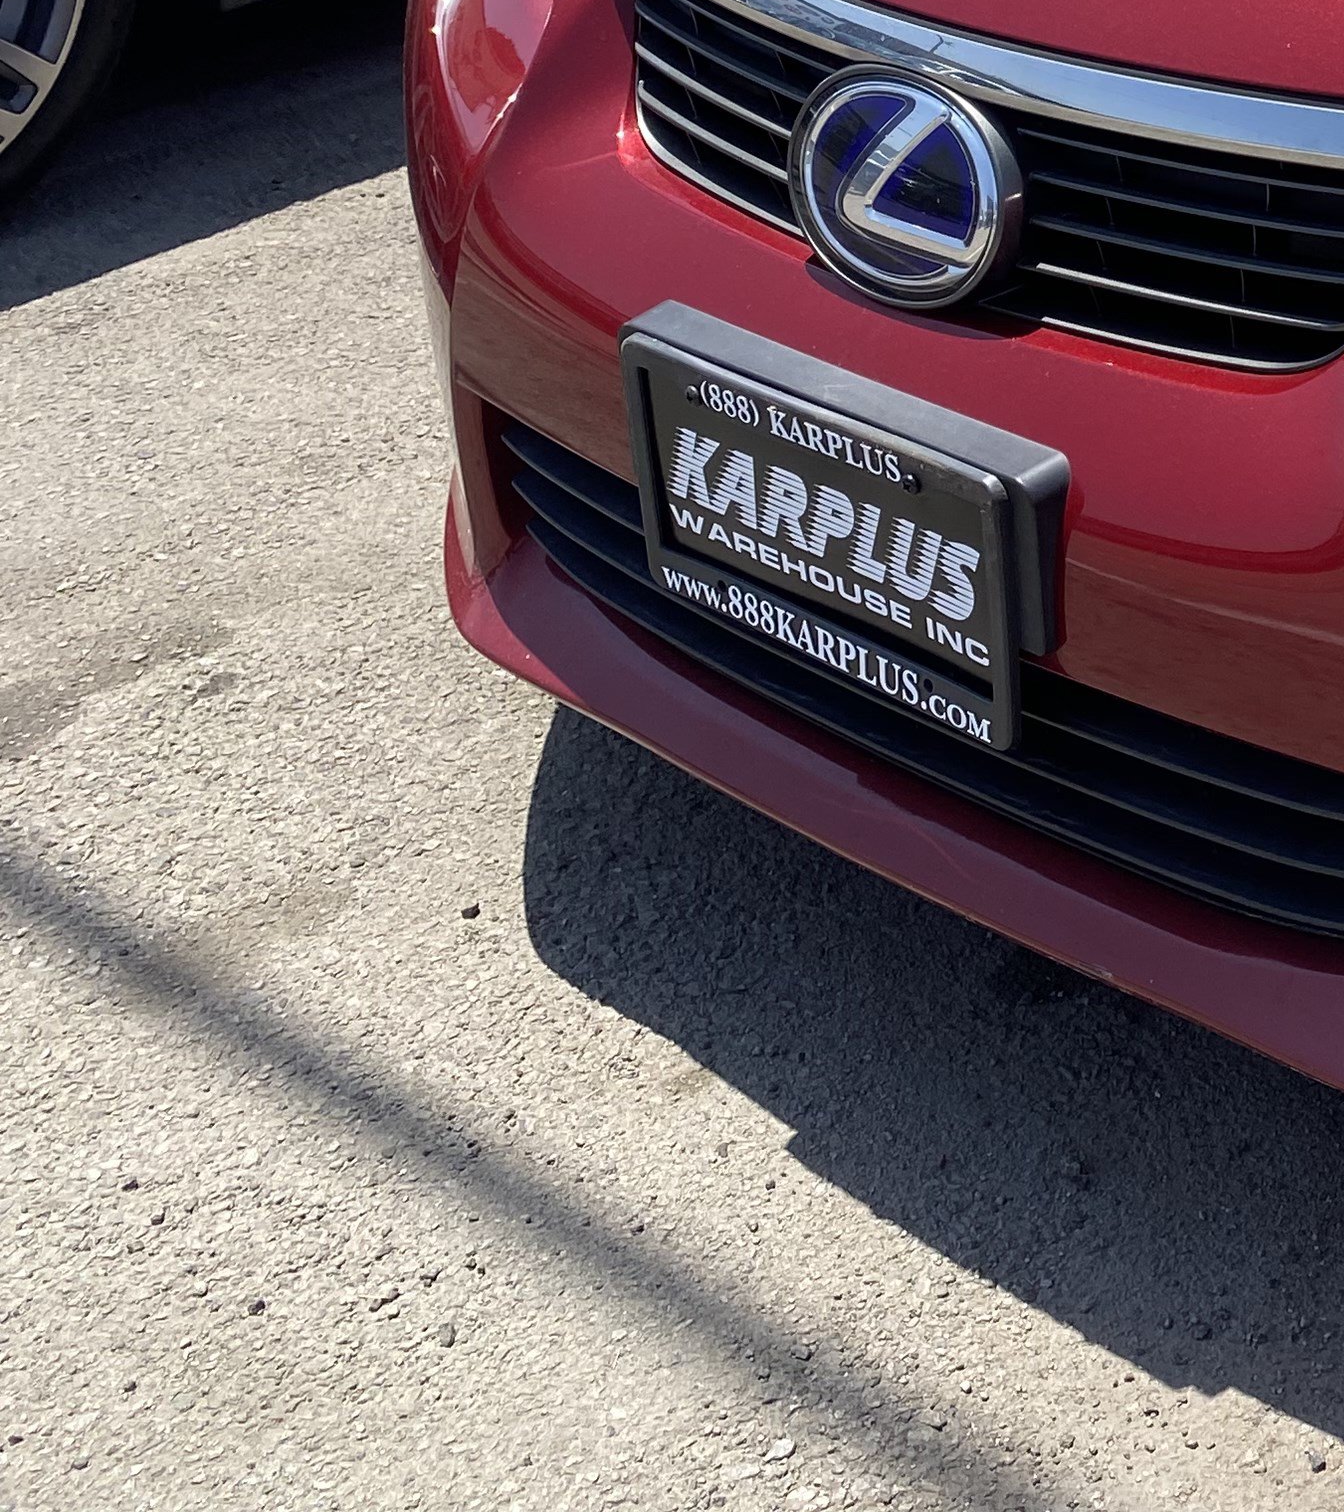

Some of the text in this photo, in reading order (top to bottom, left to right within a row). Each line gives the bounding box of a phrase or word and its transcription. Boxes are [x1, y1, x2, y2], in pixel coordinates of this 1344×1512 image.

[699, 379, 902, 484] (888) KARPLUS
[667, 425, 981, 623] KARPLUS
[668, 503, 991, 669] WAREHOUSE INC
